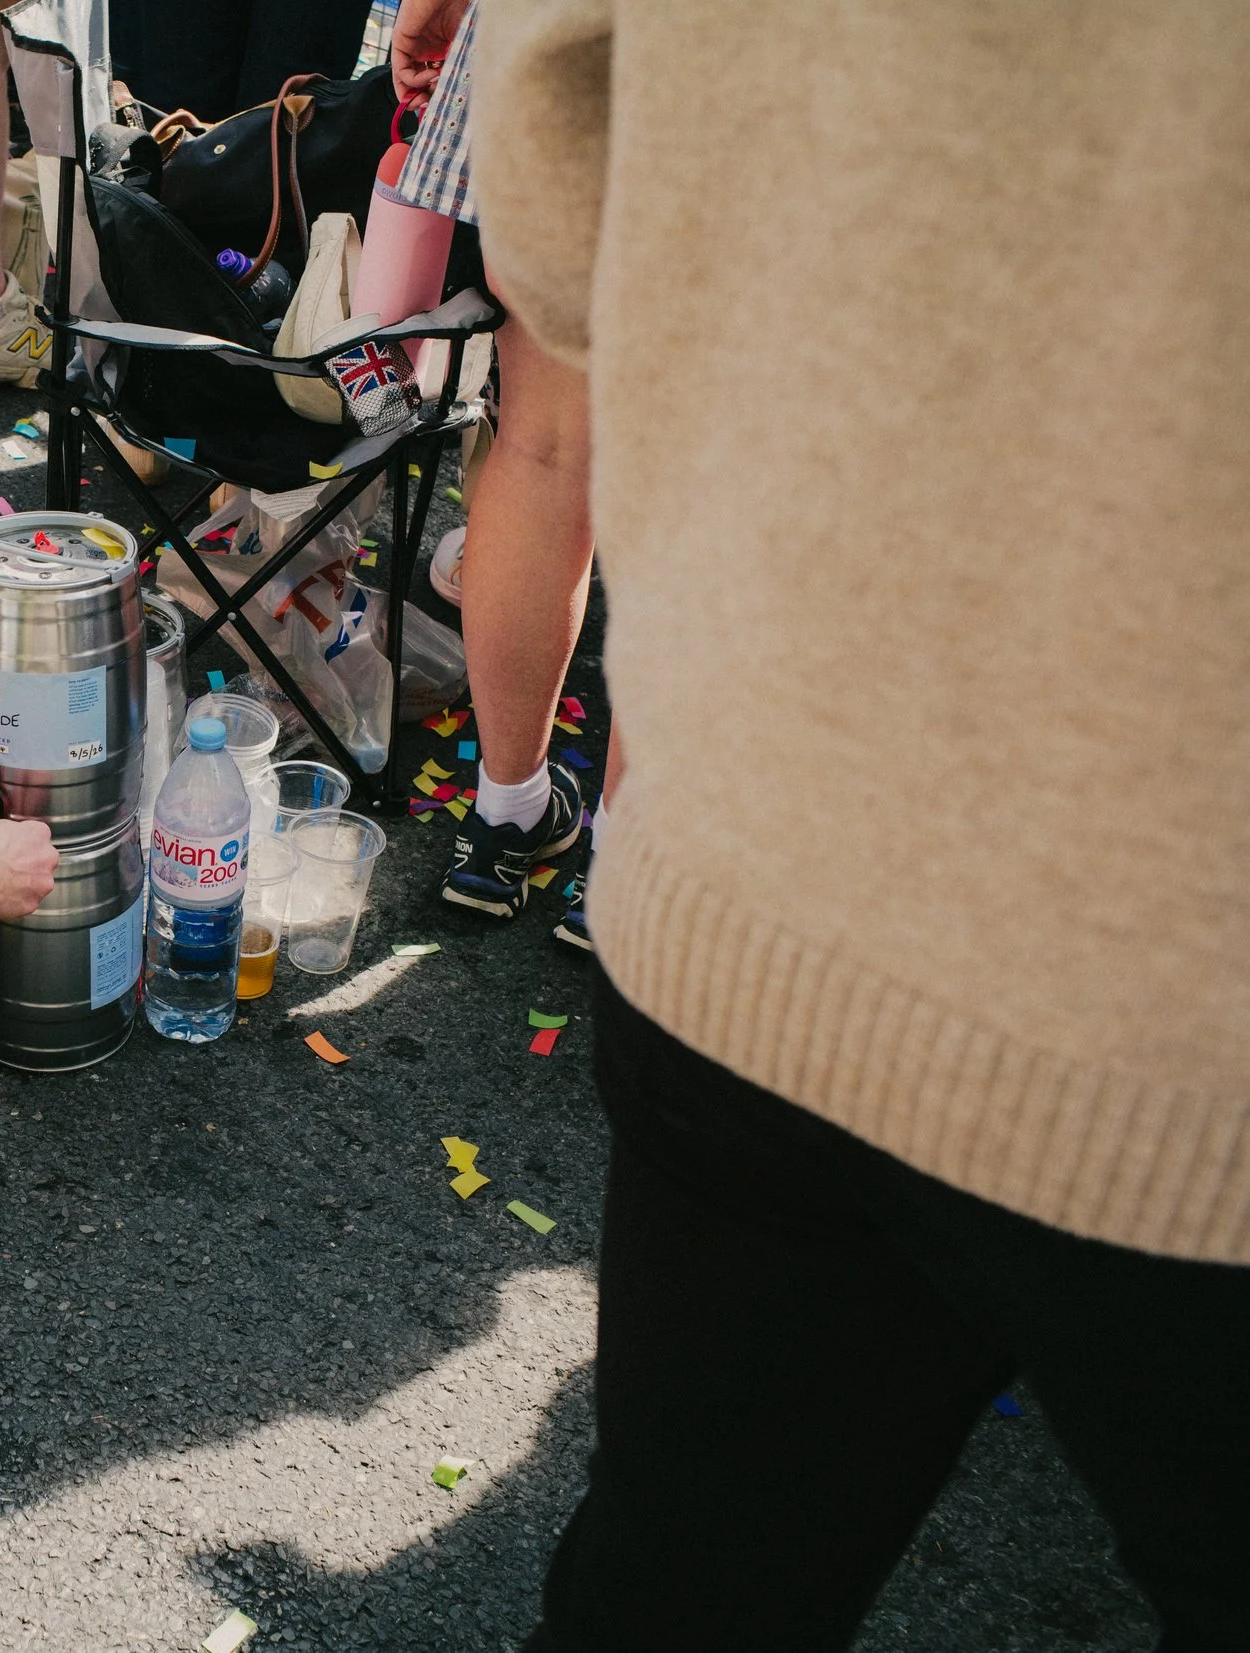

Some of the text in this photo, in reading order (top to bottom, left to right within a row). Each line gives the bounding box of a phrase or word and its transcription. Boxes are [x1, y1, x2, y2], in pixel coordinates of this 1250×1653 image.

[153, 829, 216, 867] evian
[223, 845, 238, 857] WIN
[199, 862, 238, 884] 200
